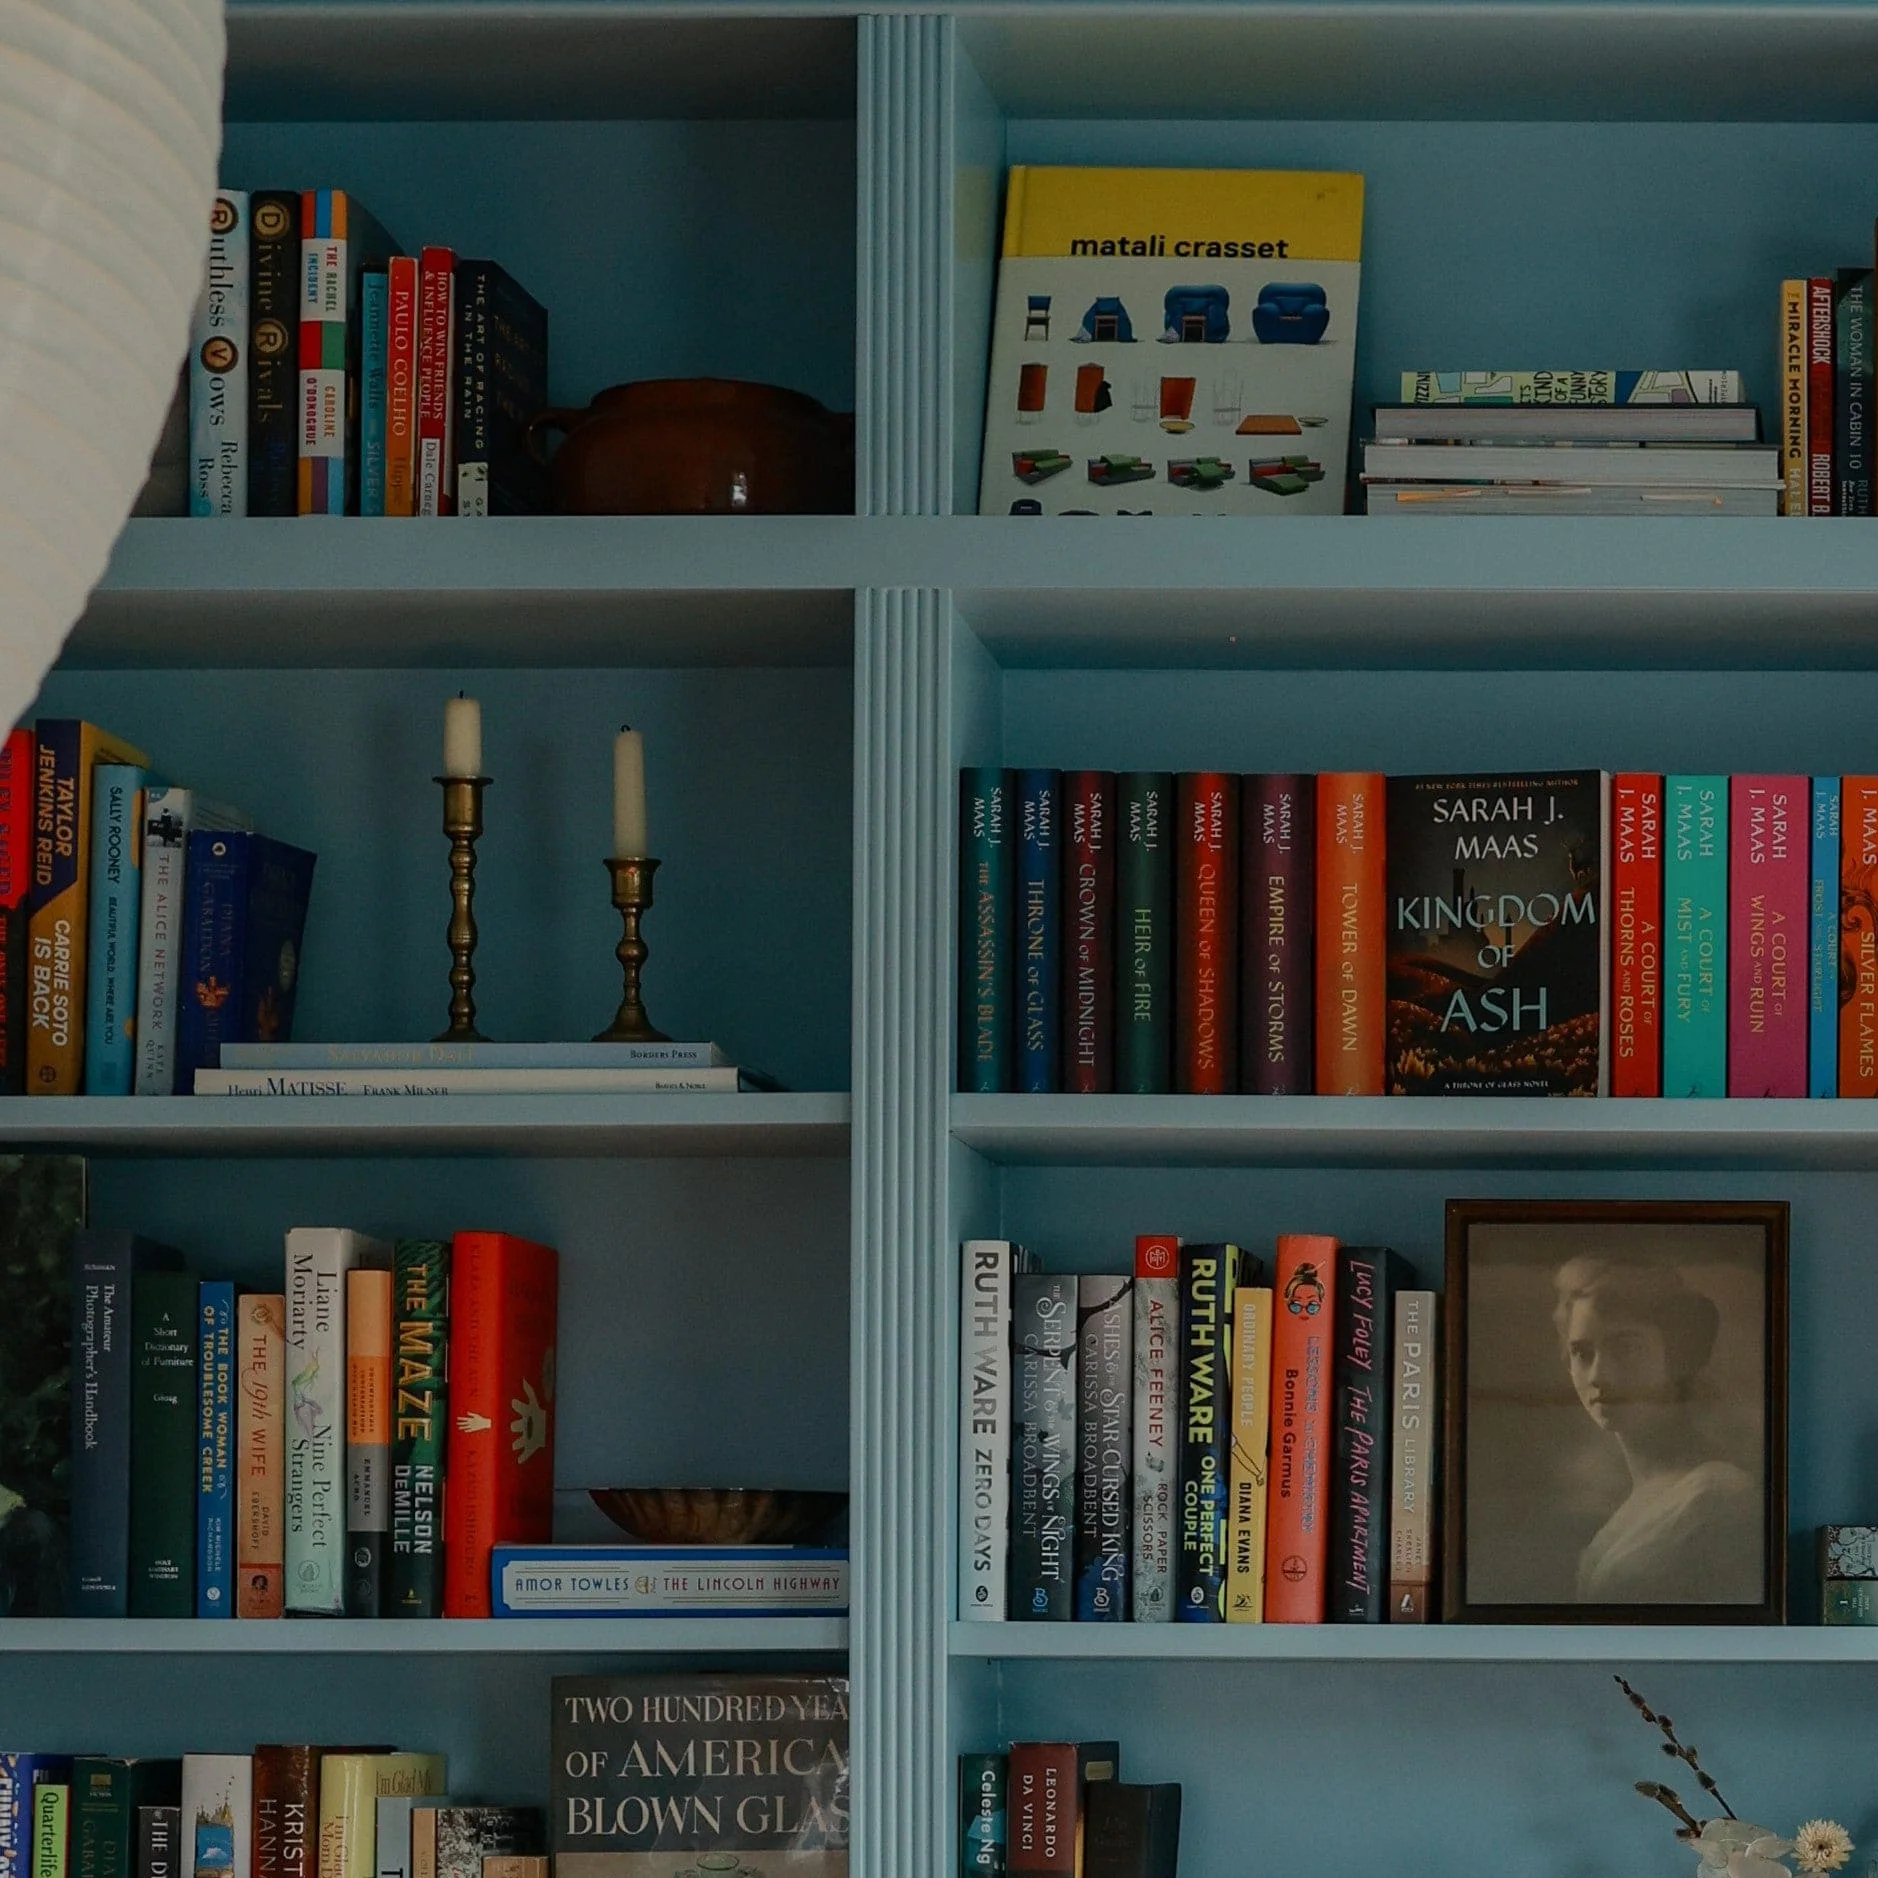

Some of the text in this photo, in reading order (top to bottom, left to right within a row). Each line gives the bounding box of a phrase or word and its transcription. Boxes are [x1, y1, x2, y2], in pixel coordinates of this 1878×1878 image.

[307, 253, 319, 304] INCIDENT
[325, 247, 338, 313] THE RACHEL
[1070, 236, 1289, 259] matali crasset
[200, 199, 238, 427] Ruthless Vows
[252, 202, 291, 425] Divine Rivals
[1812, 286, 1830, 365] AFTERSHOCK
[391, 291, 410, 437] PAULO COELHO
[475, 274, 485, 450] THE ART OF RACING
[1848, 286, 1863, 469] THE WOMAN IN CABIN 10
[36, 744, 55, 886] JENKINS REID
[55, 778, 74, 856] TAYLOR
[107, 786, 122, 884] SALLY ROONEY
[1432, 796, 1563, 826] SARAH J.
[1454, 834, 1539, 860] MAAS
[1342, 884, 1357, 953] TOWER
[1397, 892, 1597, 933] KINGDOM
[32, 937, 50, 1030] IS BACK
[51, 919, 69, 1046] CARRIE SOTO
[1477, 945, 1515, 969] OF
[1619, 887, 1635, 1057] THORNS AND ROSES
[1342, 989, 1357, 1051] DAWN
[1440, 987, 1548, 1034] ASH
[101, 1284, 114, 1352] The Amateur
[287, 1253, 314, 1350] Moriarty
[316, 1271, 339, 1333] Liane
[80, 1284, 98, 1449] Photographer's Handbook
[397, 1263, 433, 1441] THE MAZE
[1149, 1299, 1165, 1447] ALICE FEENEY
[1188, 1257, 1217, 1444] RUTH WARE
[1280, 1369, 1298, 1498] Bonnie Garmus
[287, 1439, 309, 1533] Strangers
[310, 1424, 333, 1548] Nine Perfect
[413, 1464, 434, 1553] NELSON
[516, 1578, 840, 1592] AMOR TOWLES THE LINCOLN HIGHWAY
[565, 1695, 787, 1723] TWO HUNDRED
[40, 1791, 59, 1878] Quarterlife
[567, 1795, 724, 1835] BLOWN
[979, 1770, 995, 1835] Celeste
[1020, 1774, 1034, 1851] DA VINCI
[1043, 1767, 1058, 1858] LEONARDO
[975, 1838, 995, 1864] Ng
